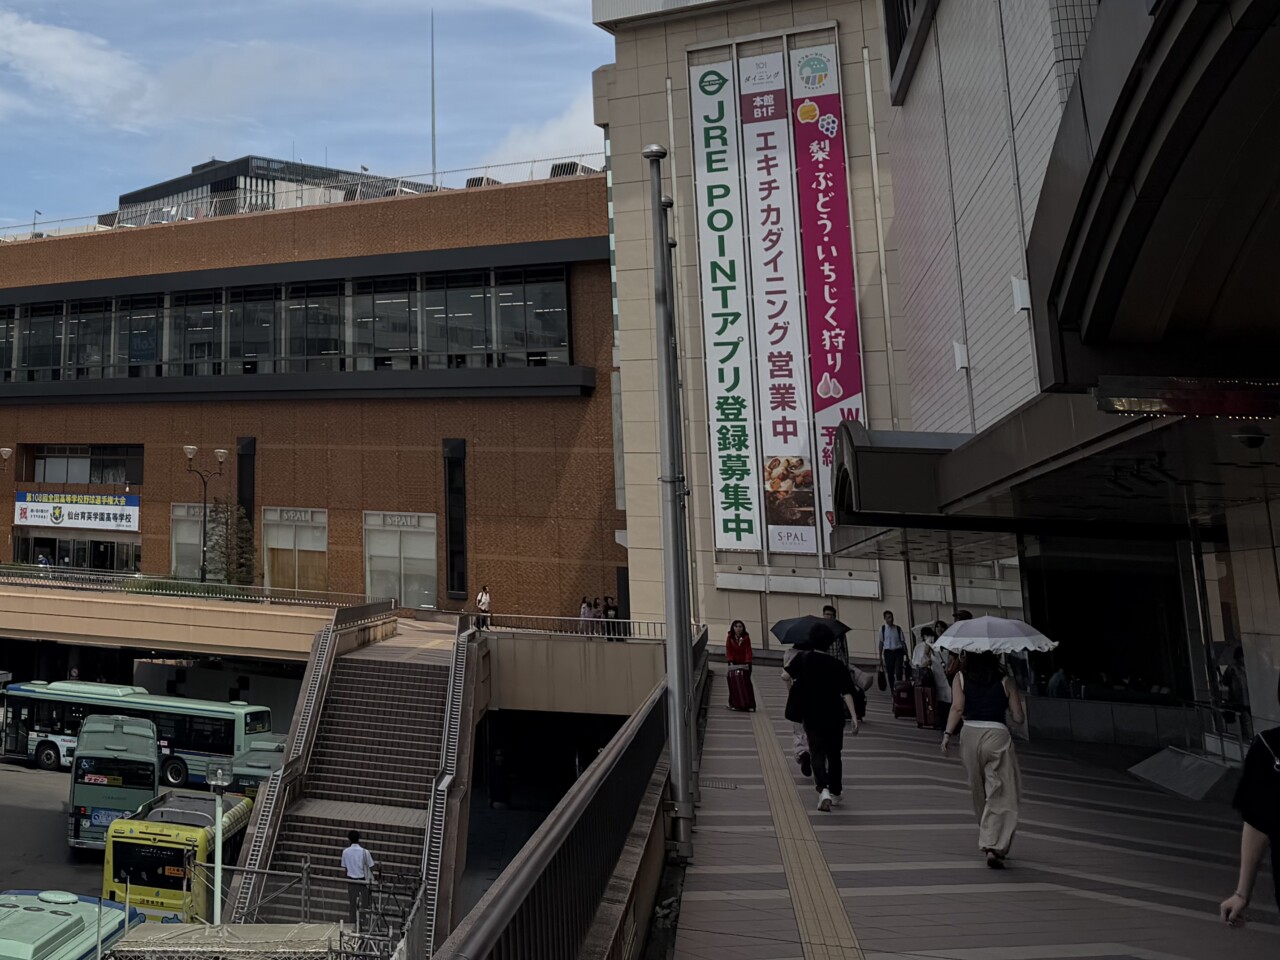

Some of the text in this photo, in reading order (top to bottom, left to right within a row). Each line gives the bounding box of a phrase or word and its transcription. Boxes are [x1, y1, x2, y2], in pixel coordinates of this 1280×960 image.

[753, 94, 774, 107] 本館
[753, 106, 775, 118] B1F
[809, 139, 846, 373] 梨・ぶどう・いちじく狩り
[755, 131, 798, 445] エキチカダイニング営業中
[703, 100, 755, 542] JRE POINTアプリ登録募集中
[67, 510, 132, 523] 仙台育英学園高等学校
[387, 515, 416, 527] S-PAL
[777, 531, 807, 542] S-PAL
